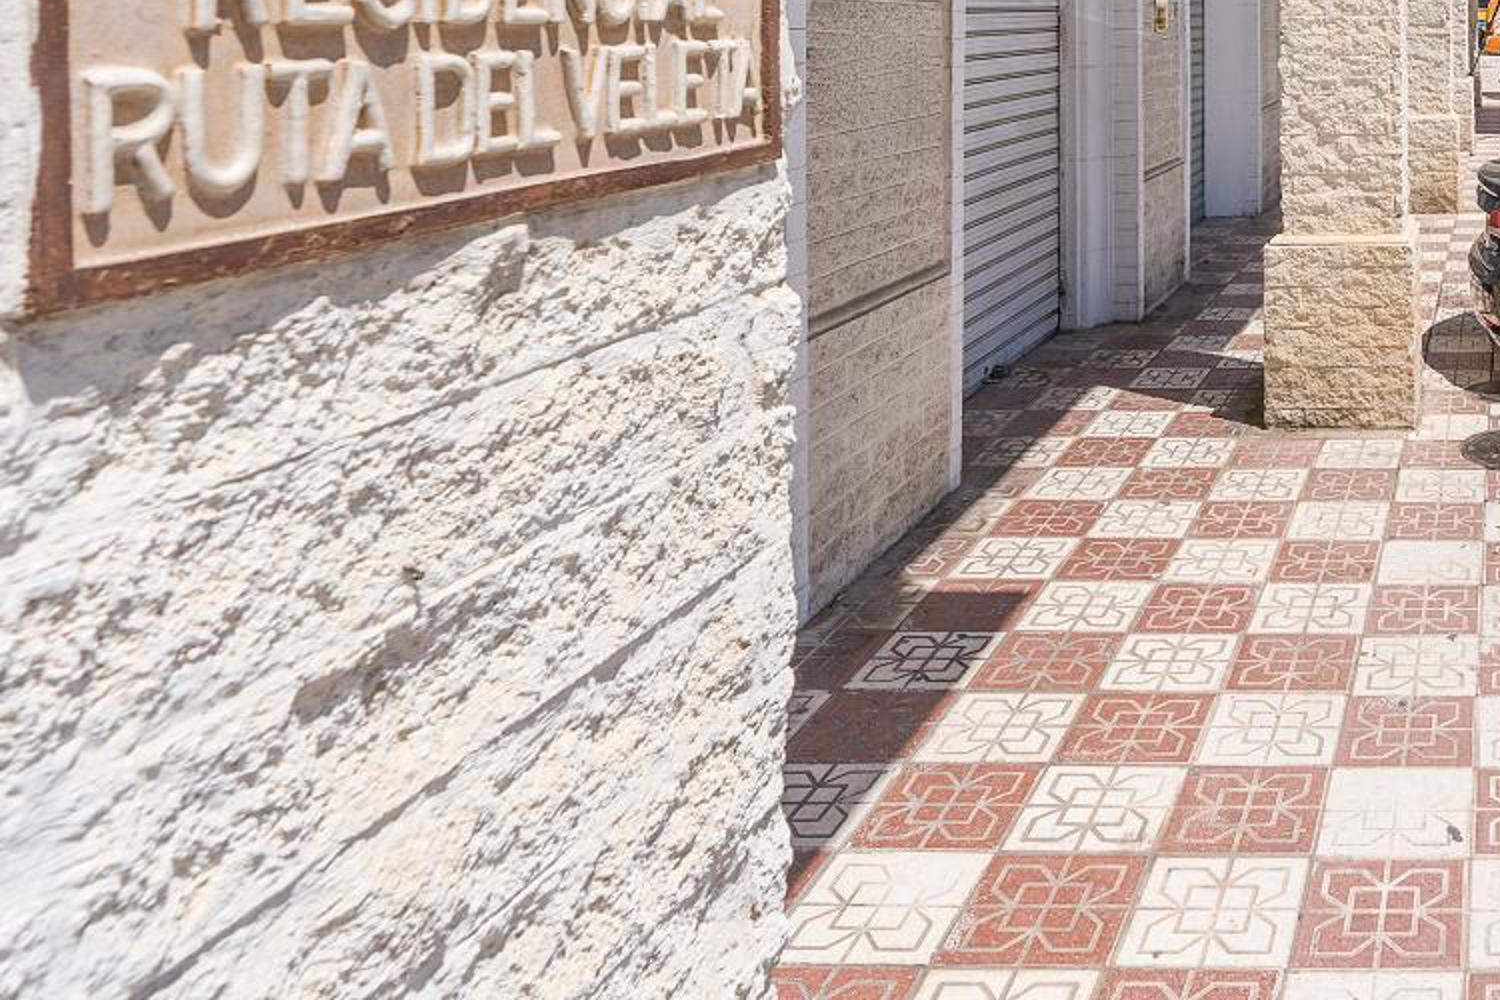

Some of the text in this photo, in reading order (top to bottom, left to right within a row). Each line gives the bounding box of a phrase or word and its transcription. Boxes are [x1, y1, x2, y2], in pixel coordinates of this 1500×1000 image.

[81, 38, 763, 216] RUTA DEL VELETA
